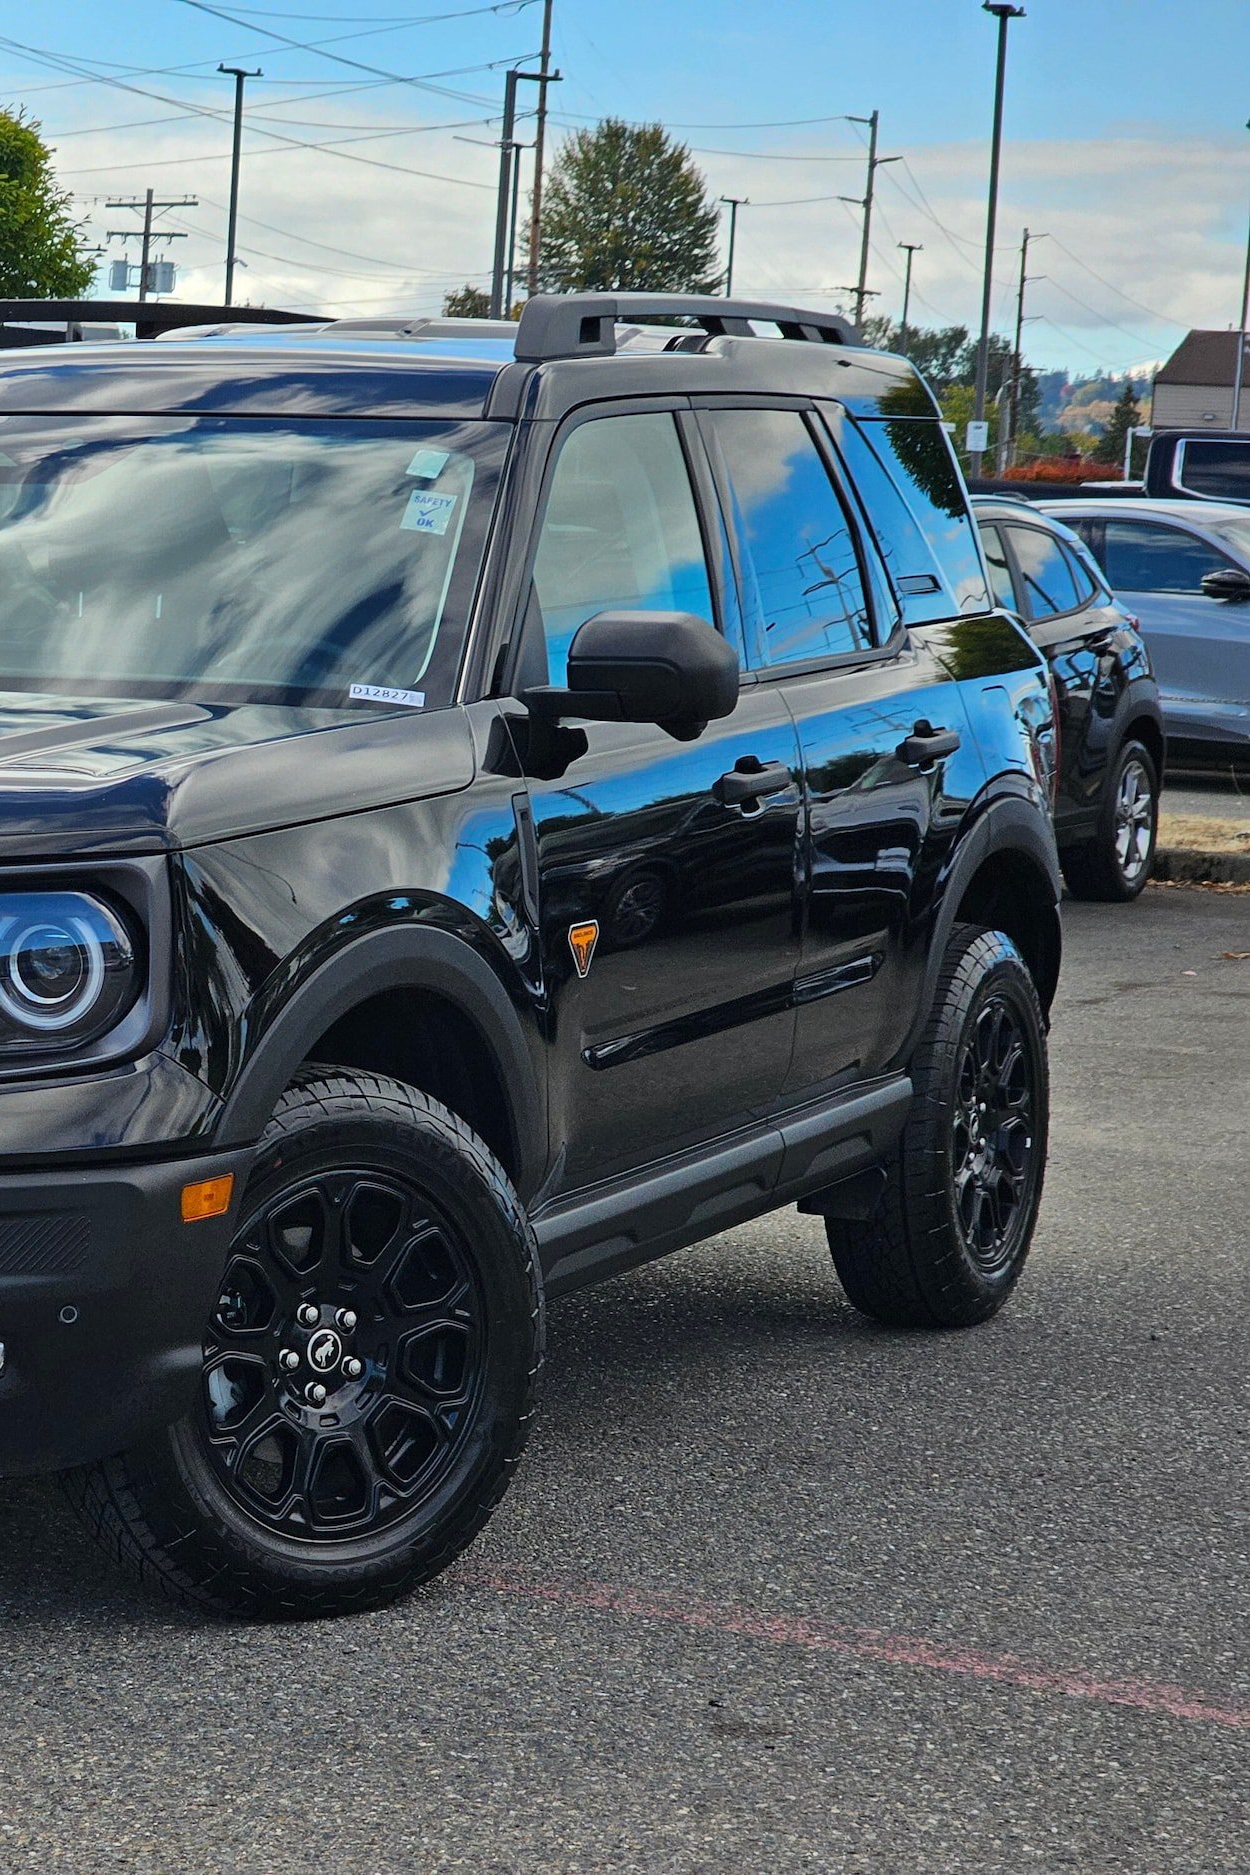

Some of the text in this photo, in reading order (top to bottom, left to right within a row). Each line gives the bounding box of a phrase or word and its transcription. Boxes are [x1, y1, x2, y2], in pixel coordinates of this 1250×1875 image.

[414, 496, 452, 508] SAFETY
[416, 517, 435, 528] OK
[352, 686, 409, 701] D12827
